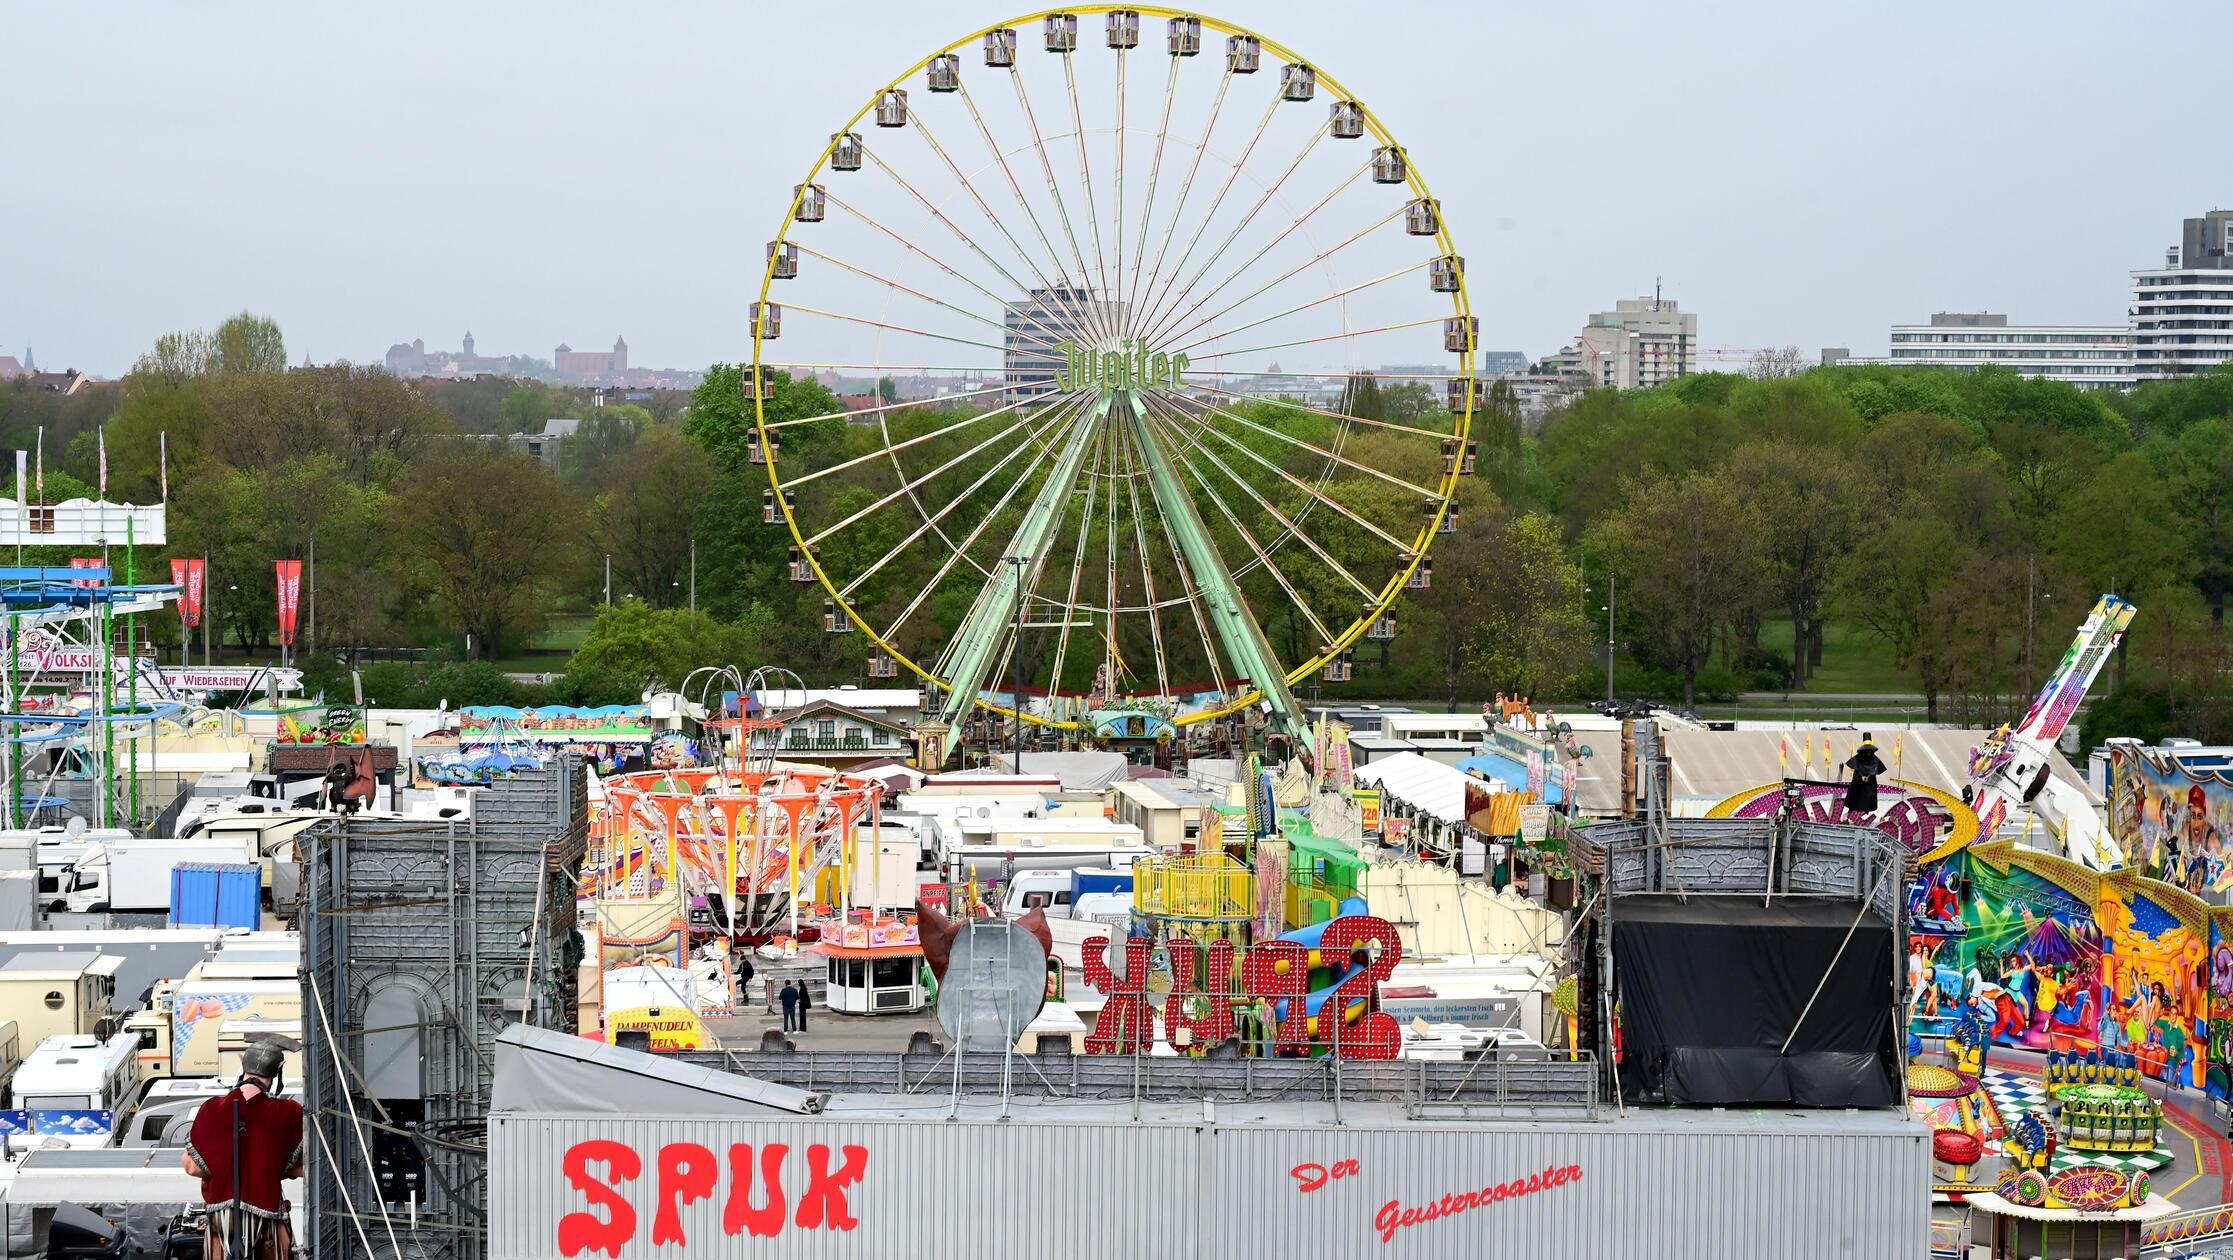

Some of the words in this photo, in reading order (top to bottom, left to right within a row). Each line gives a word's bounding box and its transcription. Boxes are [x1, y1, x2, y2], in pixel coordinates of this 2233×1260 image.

[1053, 337, 1191, 399] Jupiter
[184, 674, 247, 686] WIEDERSEHEN
[329, 709, 352, 718] GREEN
[328, 717, 355, 728] ENERGY
[1478, 1004, 1494, 1012] Fisch
[617, 1021, 693, 1031] DAMPFNUDELN
[1291, 1158, 1359, 1192] Der
[558, 1139, 868, 1258] SPUK
[1375, 1164, 1582, 1243] Geistercoaster
